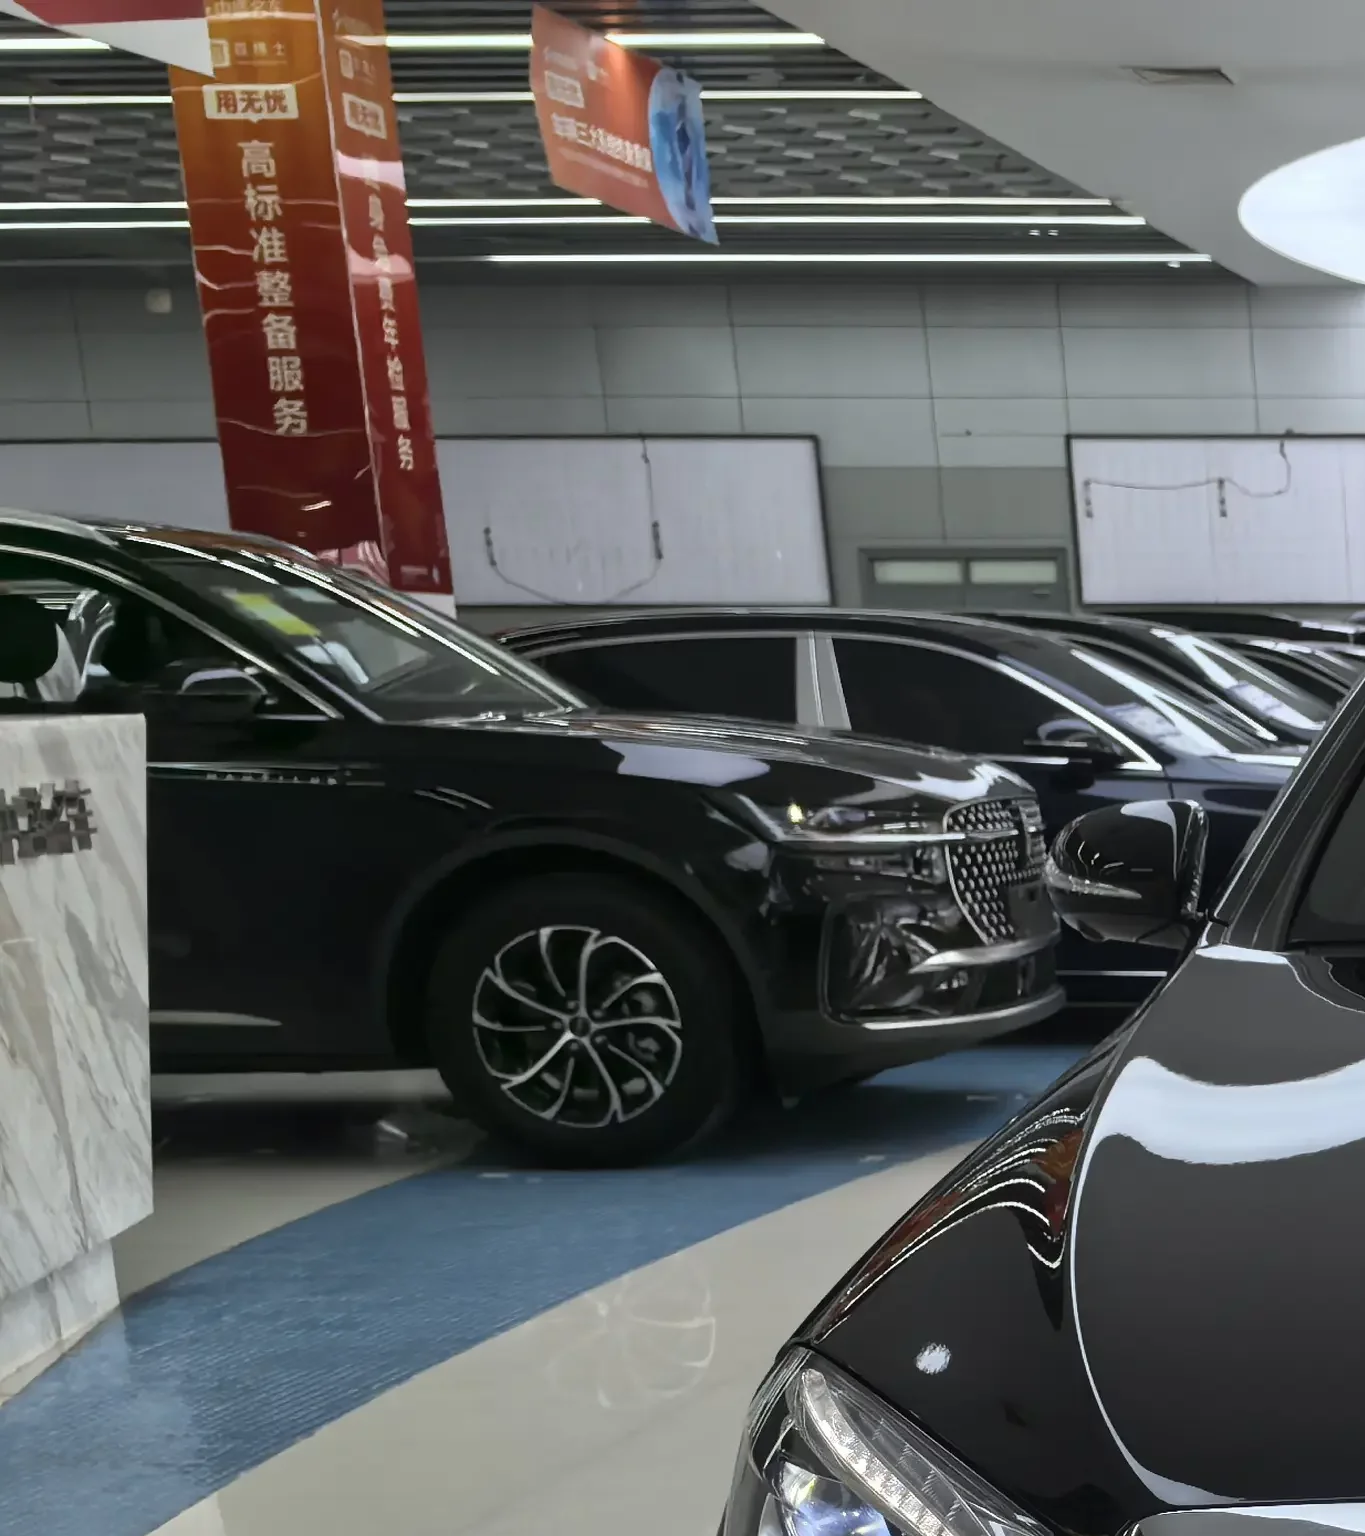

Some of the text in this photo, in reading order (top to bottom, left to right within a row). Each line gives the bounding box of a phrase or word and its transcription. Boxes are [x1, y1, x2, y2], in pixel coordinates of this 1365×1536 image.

[216, 88, 288, 115] 用无忧
[237, 138, 309, 437] 高标准整备服务
